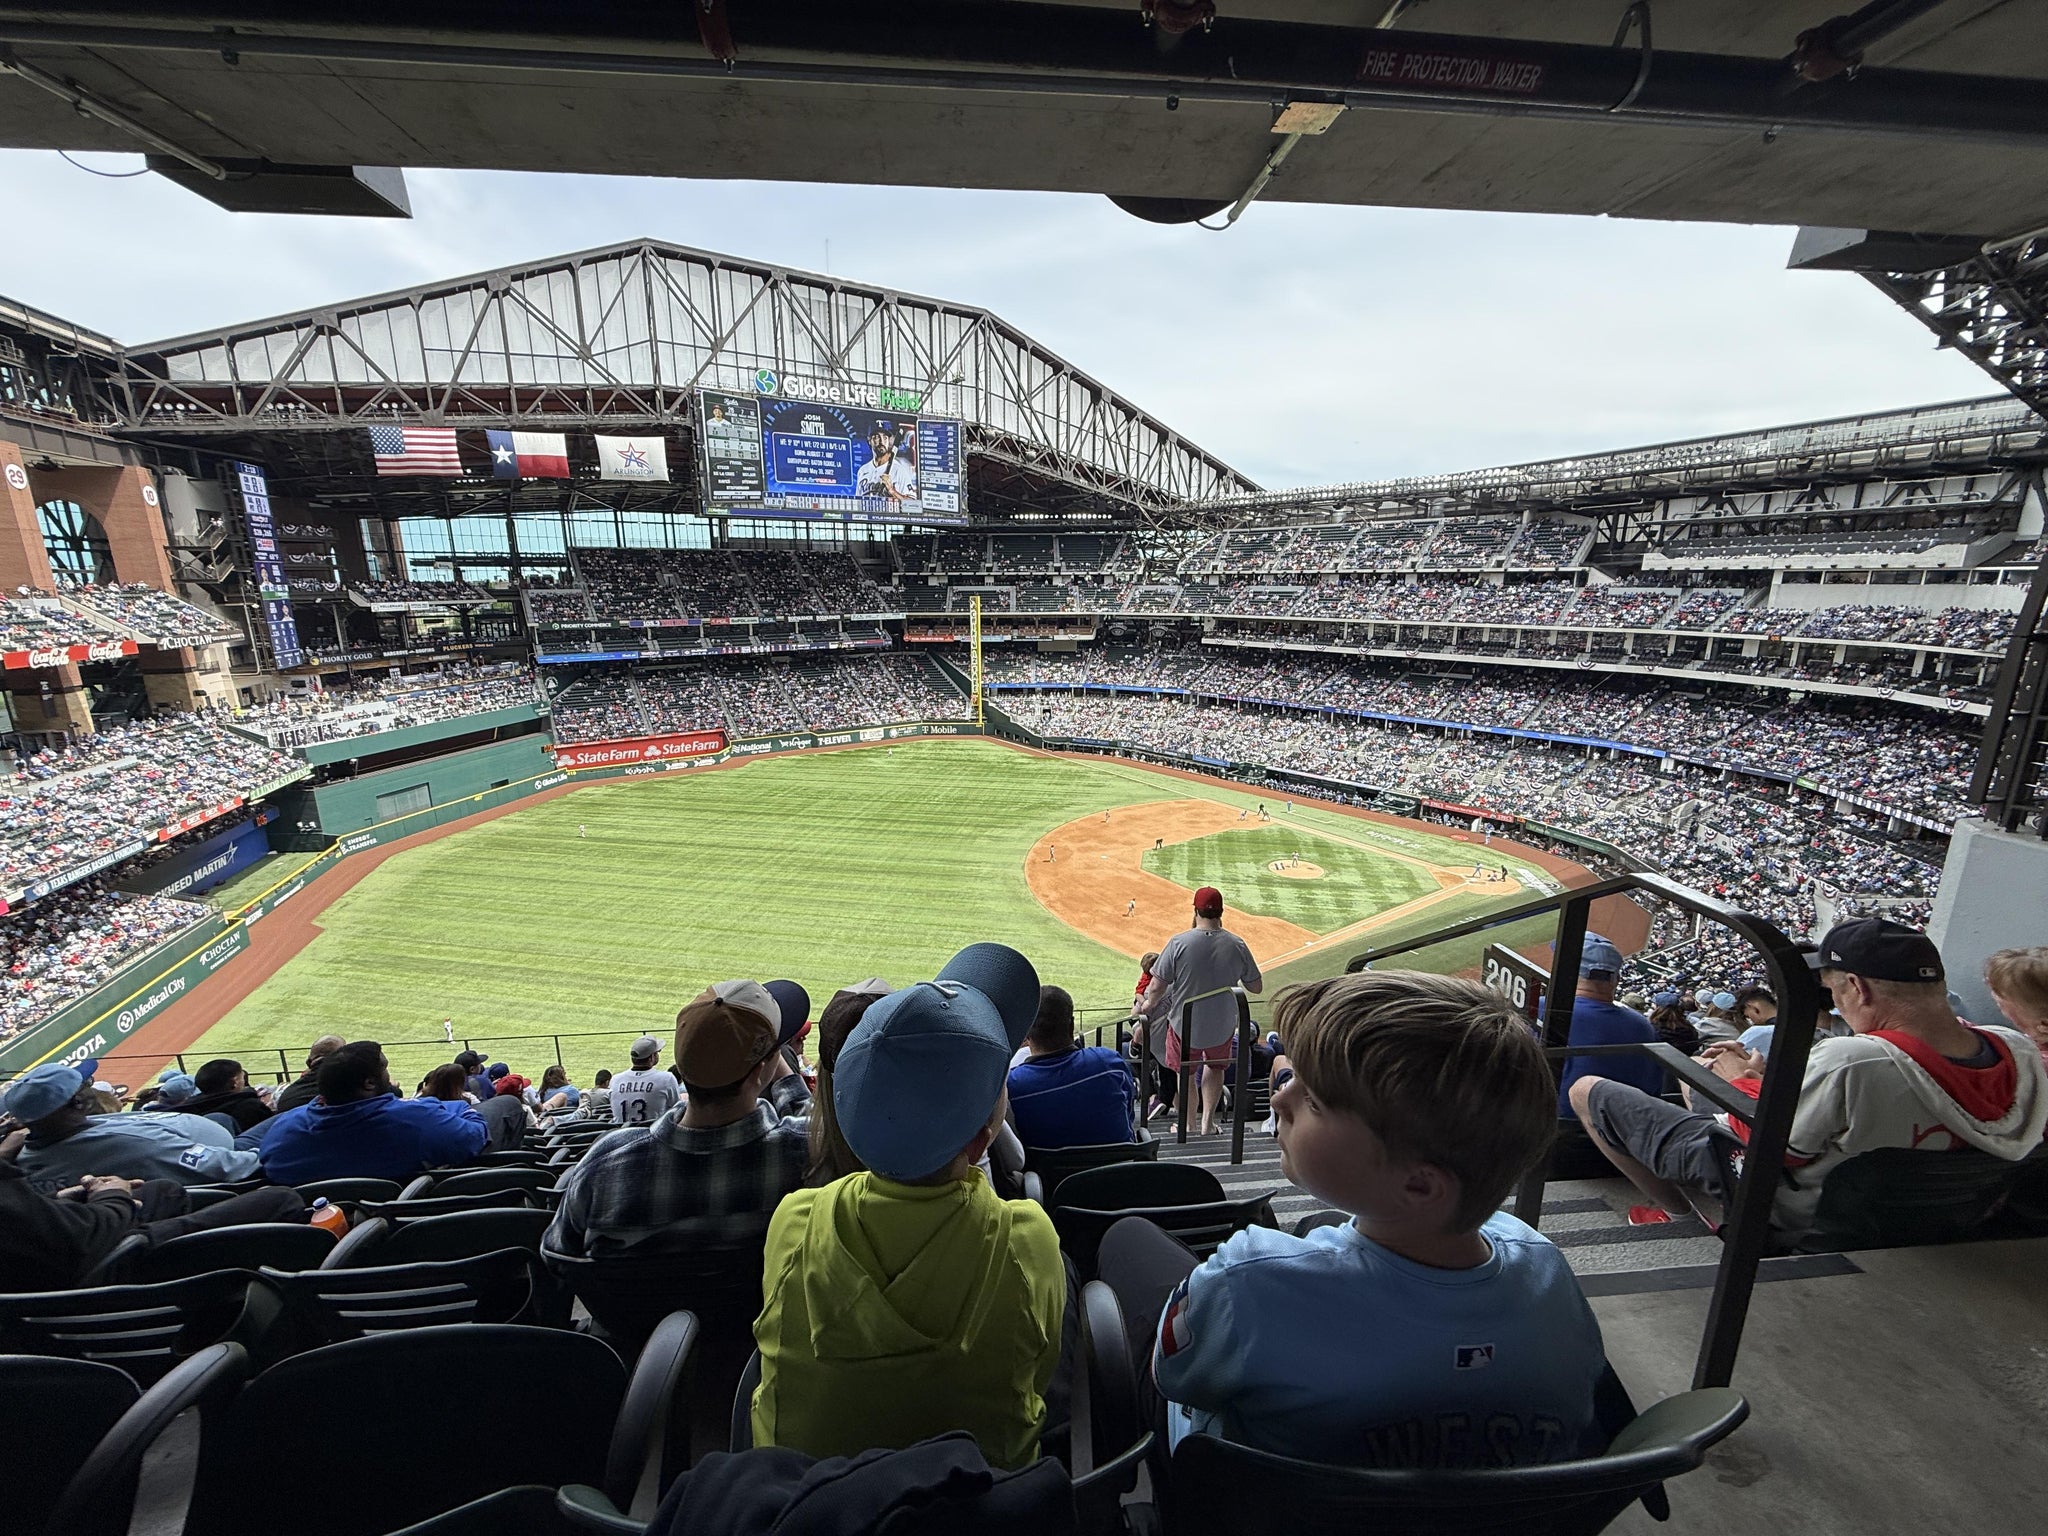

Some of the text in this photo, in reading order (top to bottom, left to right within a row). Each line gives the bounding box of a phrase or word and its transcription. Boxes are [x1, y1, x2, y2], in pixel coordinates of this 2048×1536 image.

[1363, 51, 1542, 88] FIRE PROTECTION WATER
[783, 377, 921, 411] Globe Life Field
[800, 420, 825, 435] SMITH
[9, 471, 24, 484] 29
[146, 489, 155, 502] 10
[166, 634, 212, 650] CHOCTAW
[442, 643, 473, 651] PLUCKERS
[29, 647, 69, 669] Coca-Cola
[88, 642, 123, 661] Coca-Cola
[320, 652, 373, 663] PRIORITY GOLD
[930, 726, 957, 734] Mobile
[740, 742, 772, 752] National
[789, 737, 811, 749] Kroger
[818, 735, 851, 746] 7-ELEVEN
[280, 767, 311, 787] STAFFING
[625, 766, 655, 775] Kubota
[542, 773, 567, 787] Globe Life
[347, 834, 370, 846] ENERGY
[349, 838, 377, 850] TRANSFER
[50, 840, 143, 889] TEXAS RANGERS BASEBALL FOUNDATION
[154, 855, 227, 898] CKHEED MARTIN
[204, 931, 240, 962] CHOCTAW
[1485, 958, 1526, 1008] 206
[133, 977, 185, 1020] Medical City
[58, 1034, 106, 1067] OYOTA
[619, 1082, 654, 1094] GALLO
[620, 1098, 647, 1122] 13
[1363, 1411, 1564, 1468] WEST
